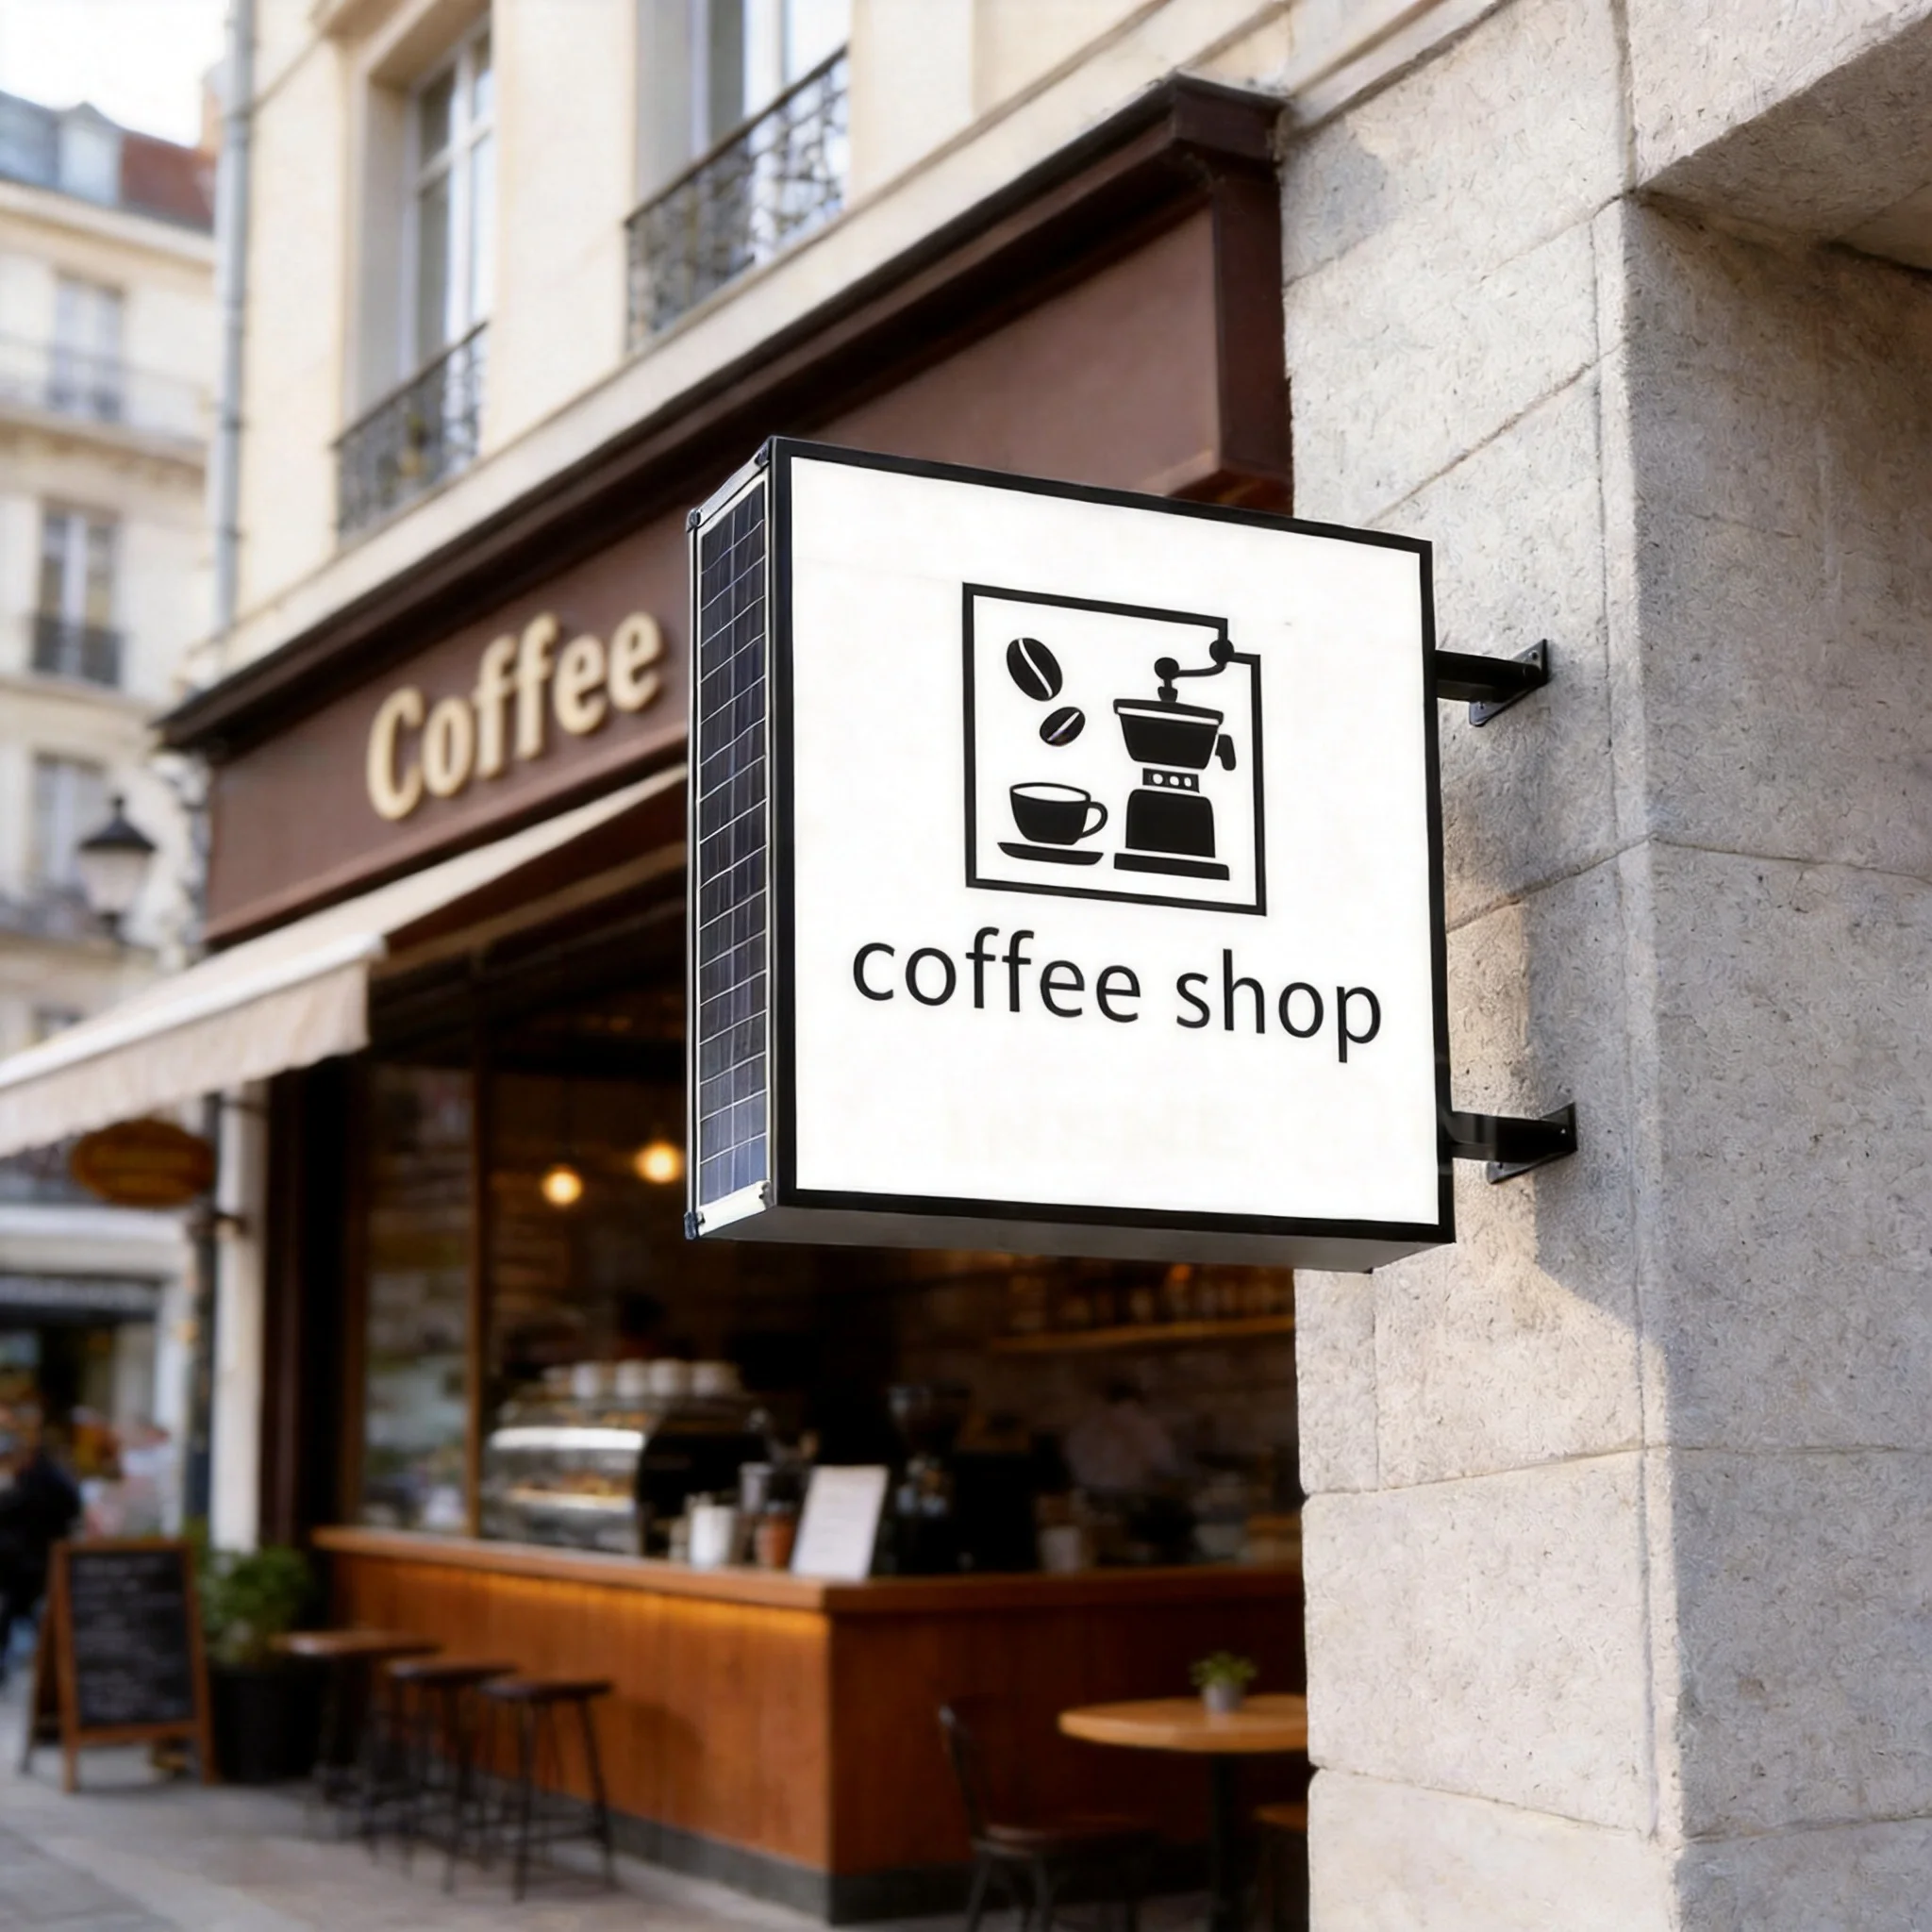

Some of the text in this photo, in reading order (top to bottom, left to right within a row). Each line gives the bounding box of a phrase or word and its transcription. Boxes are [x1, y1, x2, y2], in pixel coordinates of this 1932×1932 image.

[366, 611, 662, 820] Coffee
[853, 926, 1382, 1063] coffee shop
